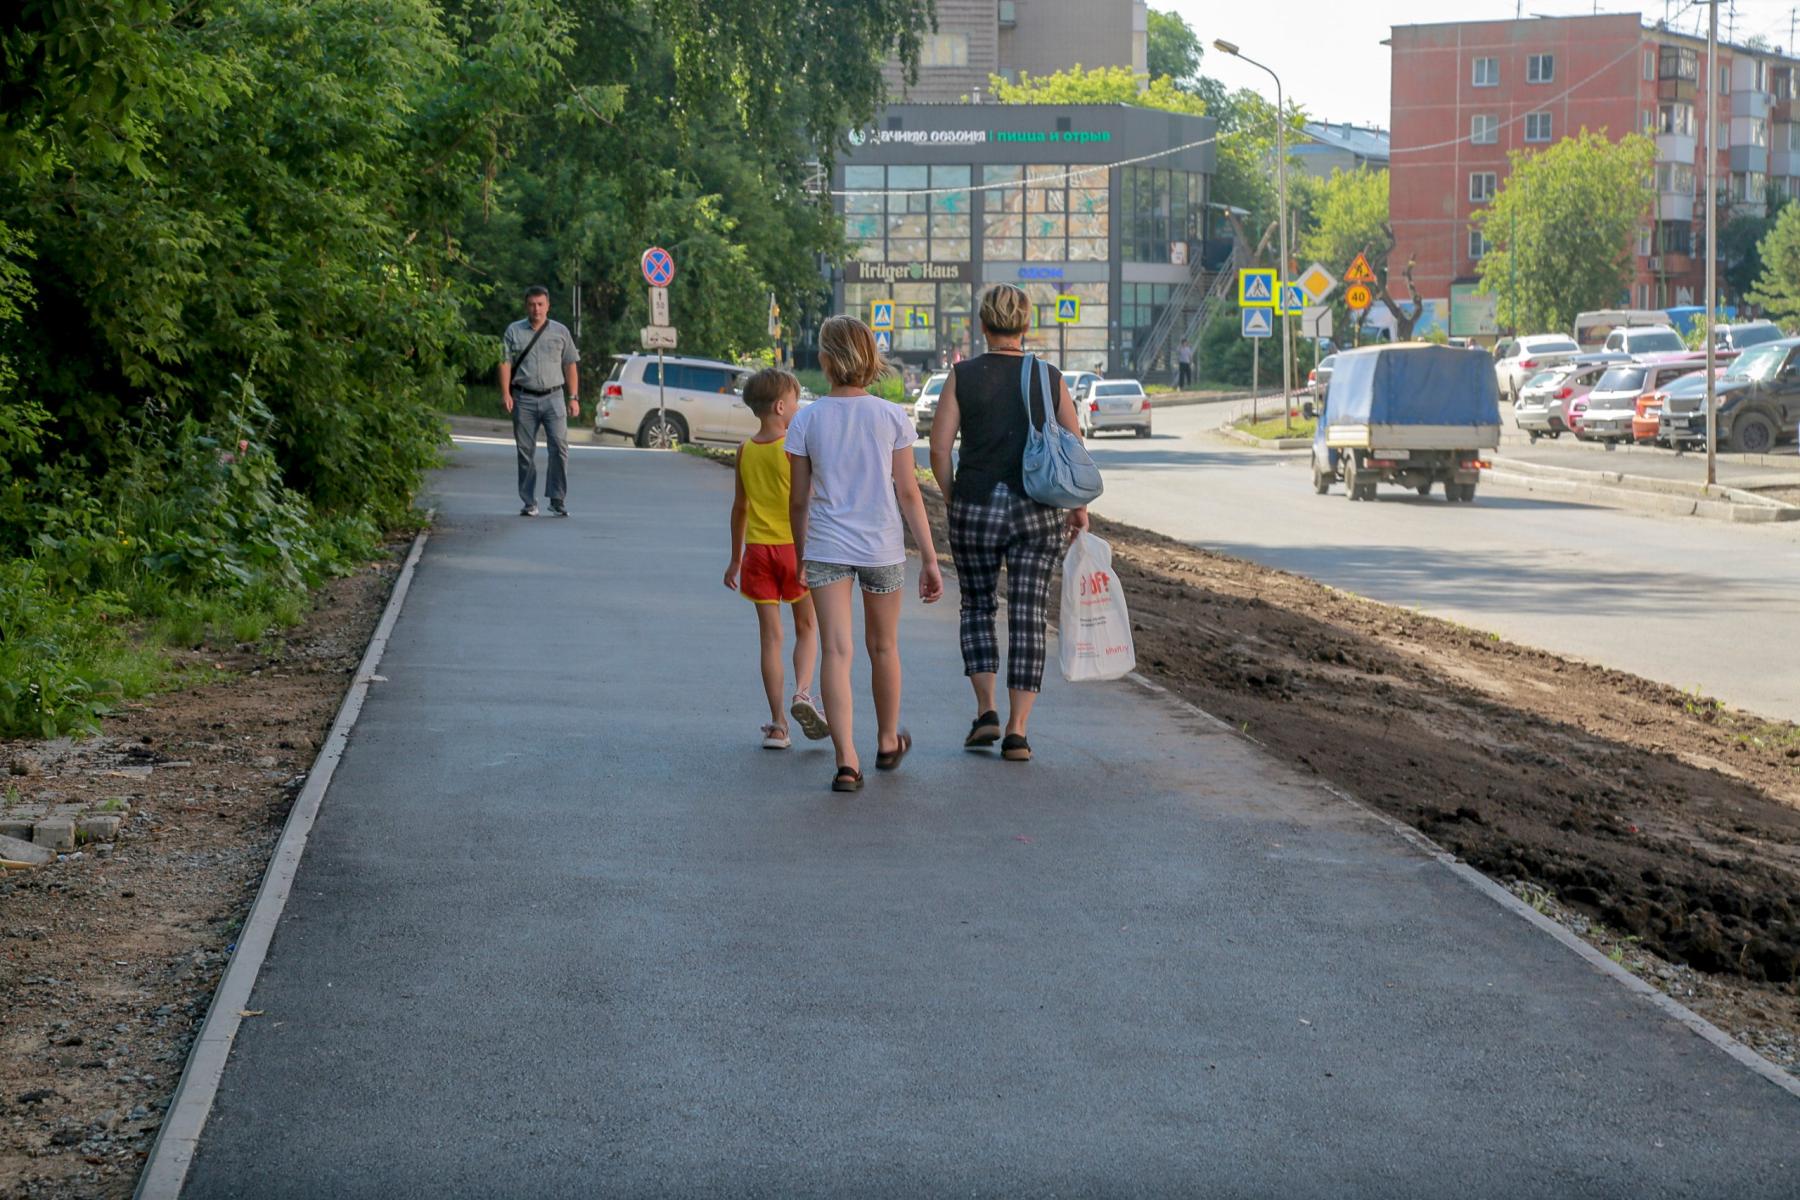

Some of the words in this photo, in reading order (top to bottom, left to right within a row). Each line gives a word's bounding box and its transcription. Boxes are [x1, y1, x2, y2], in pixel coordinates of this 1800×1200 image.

[998, 132, 1045, 143] пицца
[1050, 131, 1059, 142] и
[1063, 132, 1110, 144] отрыв
[859, 262, 911, 283] Krüger
[922, 262, 959, 279] Haus
[1352, 292, 1366, 302] 40
